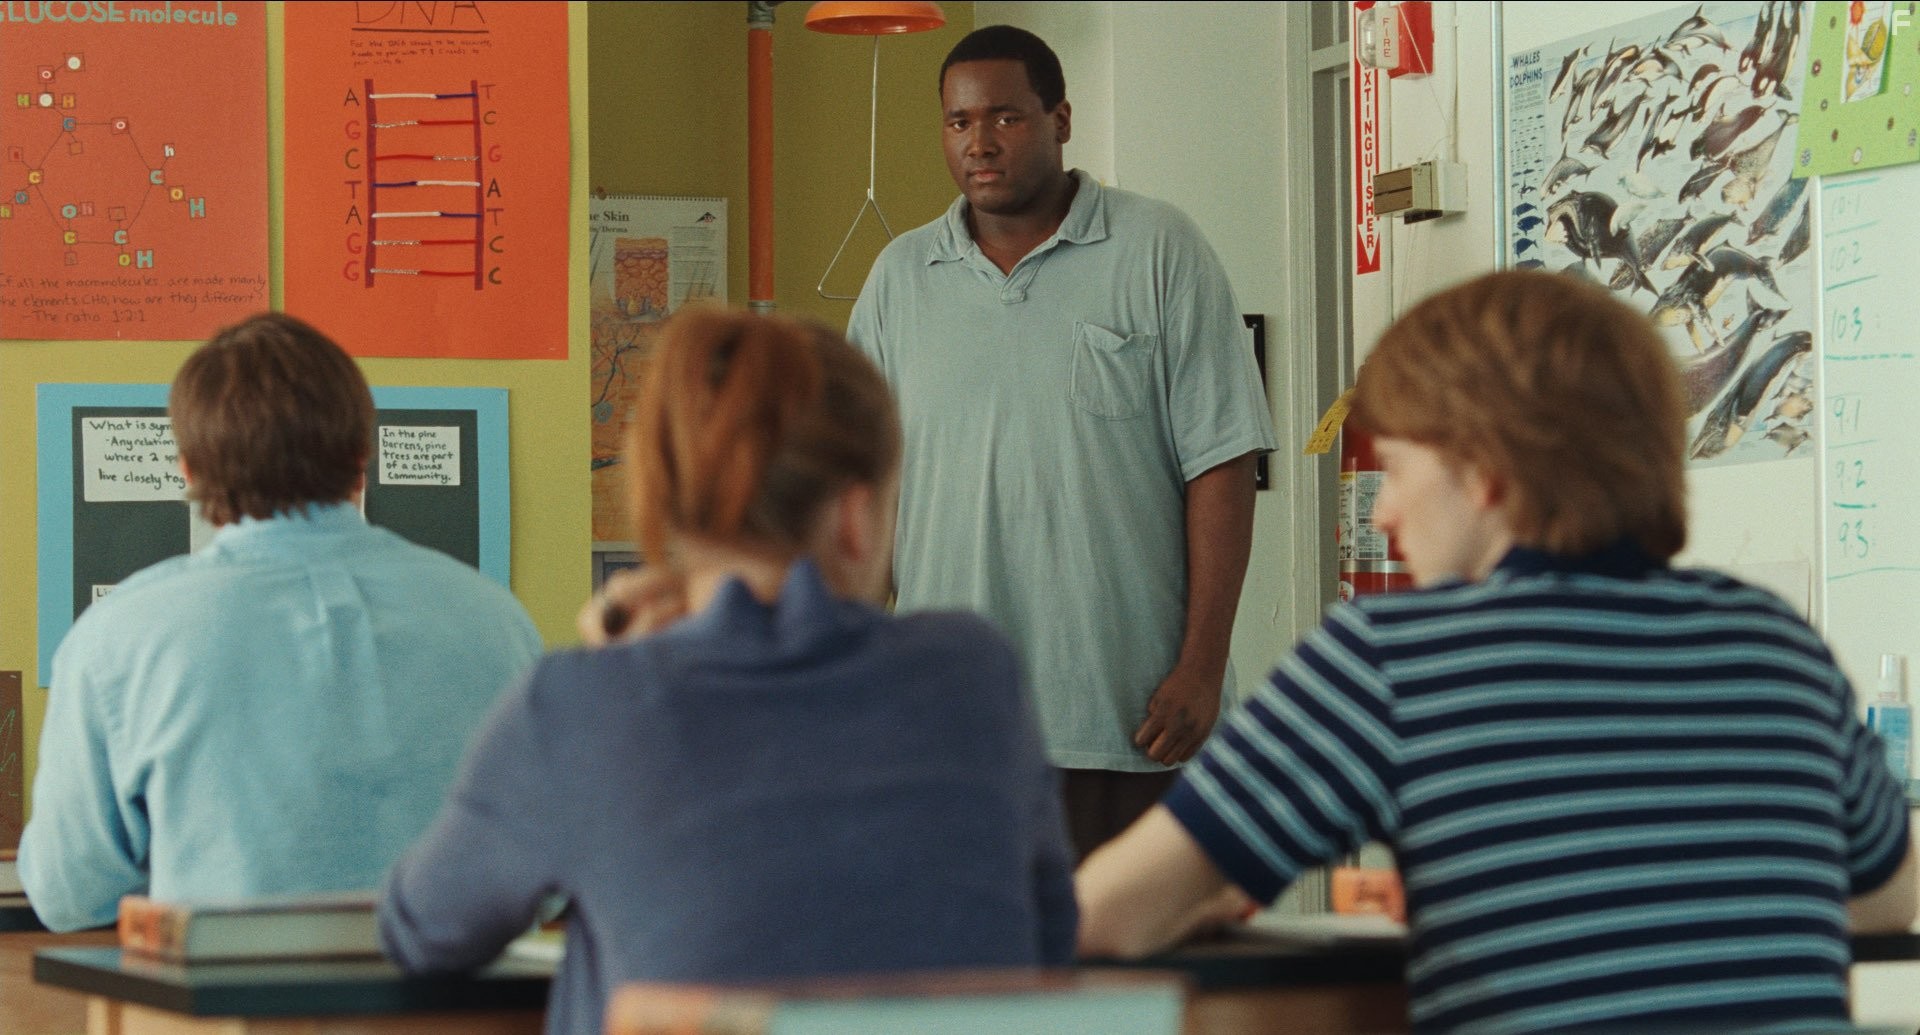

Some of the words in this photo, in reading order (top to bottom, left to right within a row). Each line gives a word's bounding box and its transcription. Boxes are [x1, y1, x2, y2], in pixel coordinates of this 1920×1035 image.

[129, 3, 238, 26] molecule
[1382, 17, 1391, 58] FIRE
[1512, 50, 1541, 69] WHALES
[1510, 67, 1543, 89] DOLPHINS
[344, 88, 360, 106] A
[481, 84, 496, 100] T
[483, 111, 497, 125] C
[345, 120, 361, 140] G
[345, 149, 361, 169] C
[487, 145, 502, 163] G
[1363, 66, 1375, 249] XTINGUISHER
[344, 181, 362, 199] T
[487, 178, 502, 198] A
[189, 198, 205, 218] H
[345, 205, 362, 225] A
[486, 208, 504, 226] T
[603, 211, 630, 222] Skin
[114, 230, 128, 244] C
[346, 232, 362, 254] G
[489, 236, 504, 253] C
[136, 250, 153, 268] H
[343, 260, 360, 282] G
[488, 267, 503, 284] C
[41, 278, 59, 287] the
[167, 278, 188, 287] are
[193, 275, 224, 285] made
[145, 296, 163, 305] are
[170, 292, 198, 313] they
[65, 310, 101, 322] ratio
[1830, 306, 1863, 341] 10.3
[89, 420, 132, 431] What
[136, 420, 147, 430] is
[383, 428, 395, 437] In
[398, 430, 415, 438] the
[418, 430, 437, 441] pine
[382, 438, 424, 452] barrens,
[425, 441, 447, 452] pine
[104, 452, 143, 463] where
[149, 452, 159, 462] 2
[383, 450, 410, 460] trees
[431, 452, 454, 463] part
[386, 461, 397, 469] of
[98, 468, 117, 481] live
[123, 471, 162, 490] closely
[164, 471, 187, 490] tog
